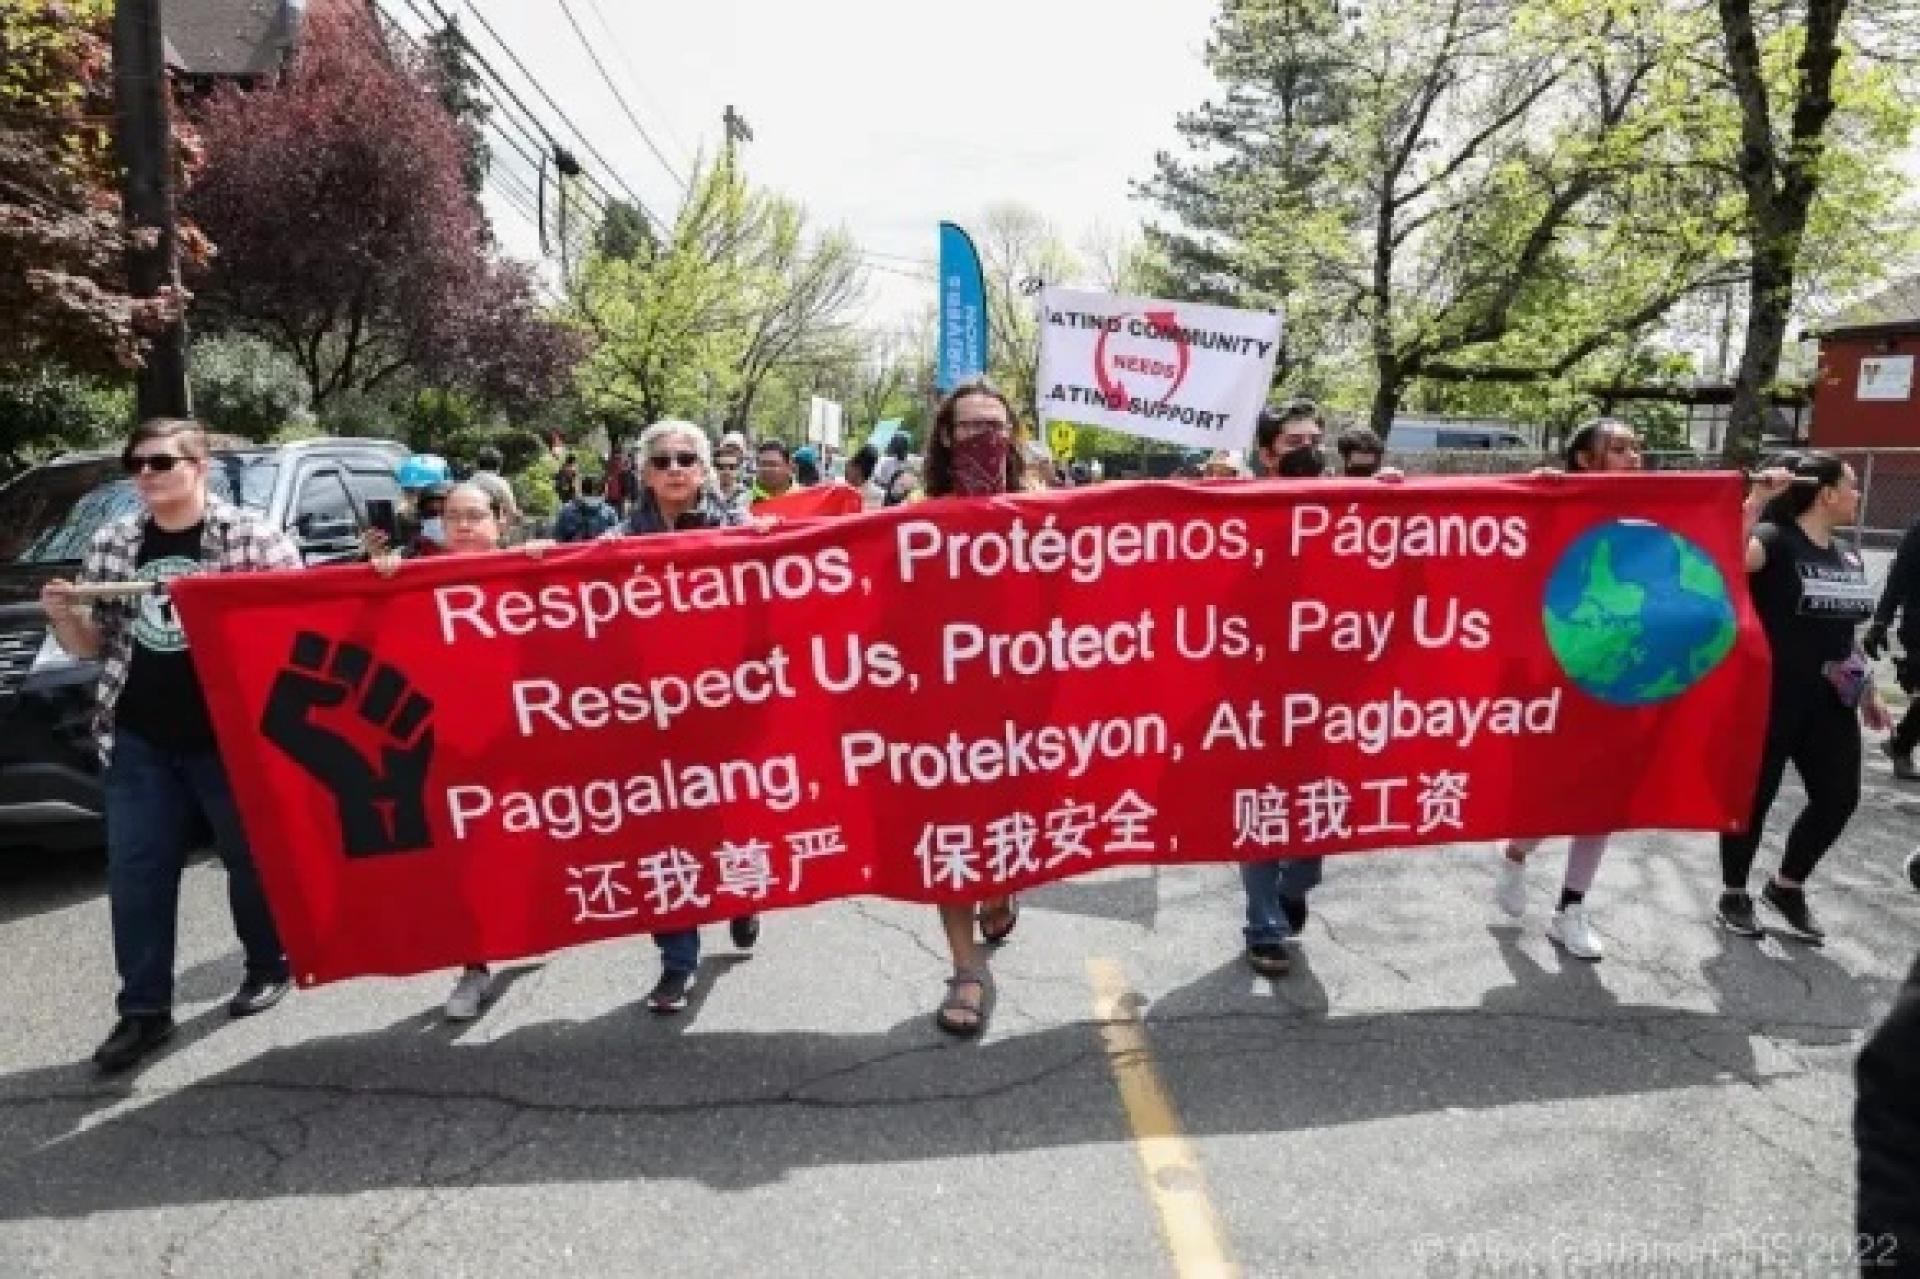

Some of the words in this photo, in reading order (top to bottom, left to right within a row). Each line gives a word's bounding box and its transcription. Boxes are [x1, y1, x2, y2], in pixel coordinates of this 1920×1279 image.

[1045, 306, 1122, 333] ATINO
[1129, 317, 1273, 359] COMMUNITY
[1114, 354, 1176, 379] NEEDS
[1045, 384, 1124, 410] ATINO
[1130, 397, 1231, 431] SUPPORT
[434, 545, 873, 645] Respétanos,
[897, 513, 1265, 583] Protégenos,
[1291, 504, 1529, 570] Páganos
[513, 645, 796, 735] Respect
[811, 633, 919, 693] Us,
[942, 608, 1155, 684] Protect
[1176, 604, 1265, 662] Us,
[1289, 600, 1396, 662] Pay
[1413, 596, 1491, 650] Us
[446, 754, 820, 840] Paggalang,
[841, 712, 1183, 788] Proteksyon,
[1201, 700, 1265, 751] At
[1283, 687, 1561, 754] Pagbayad
[1231, 770, 1470, 849] 赔我工资
